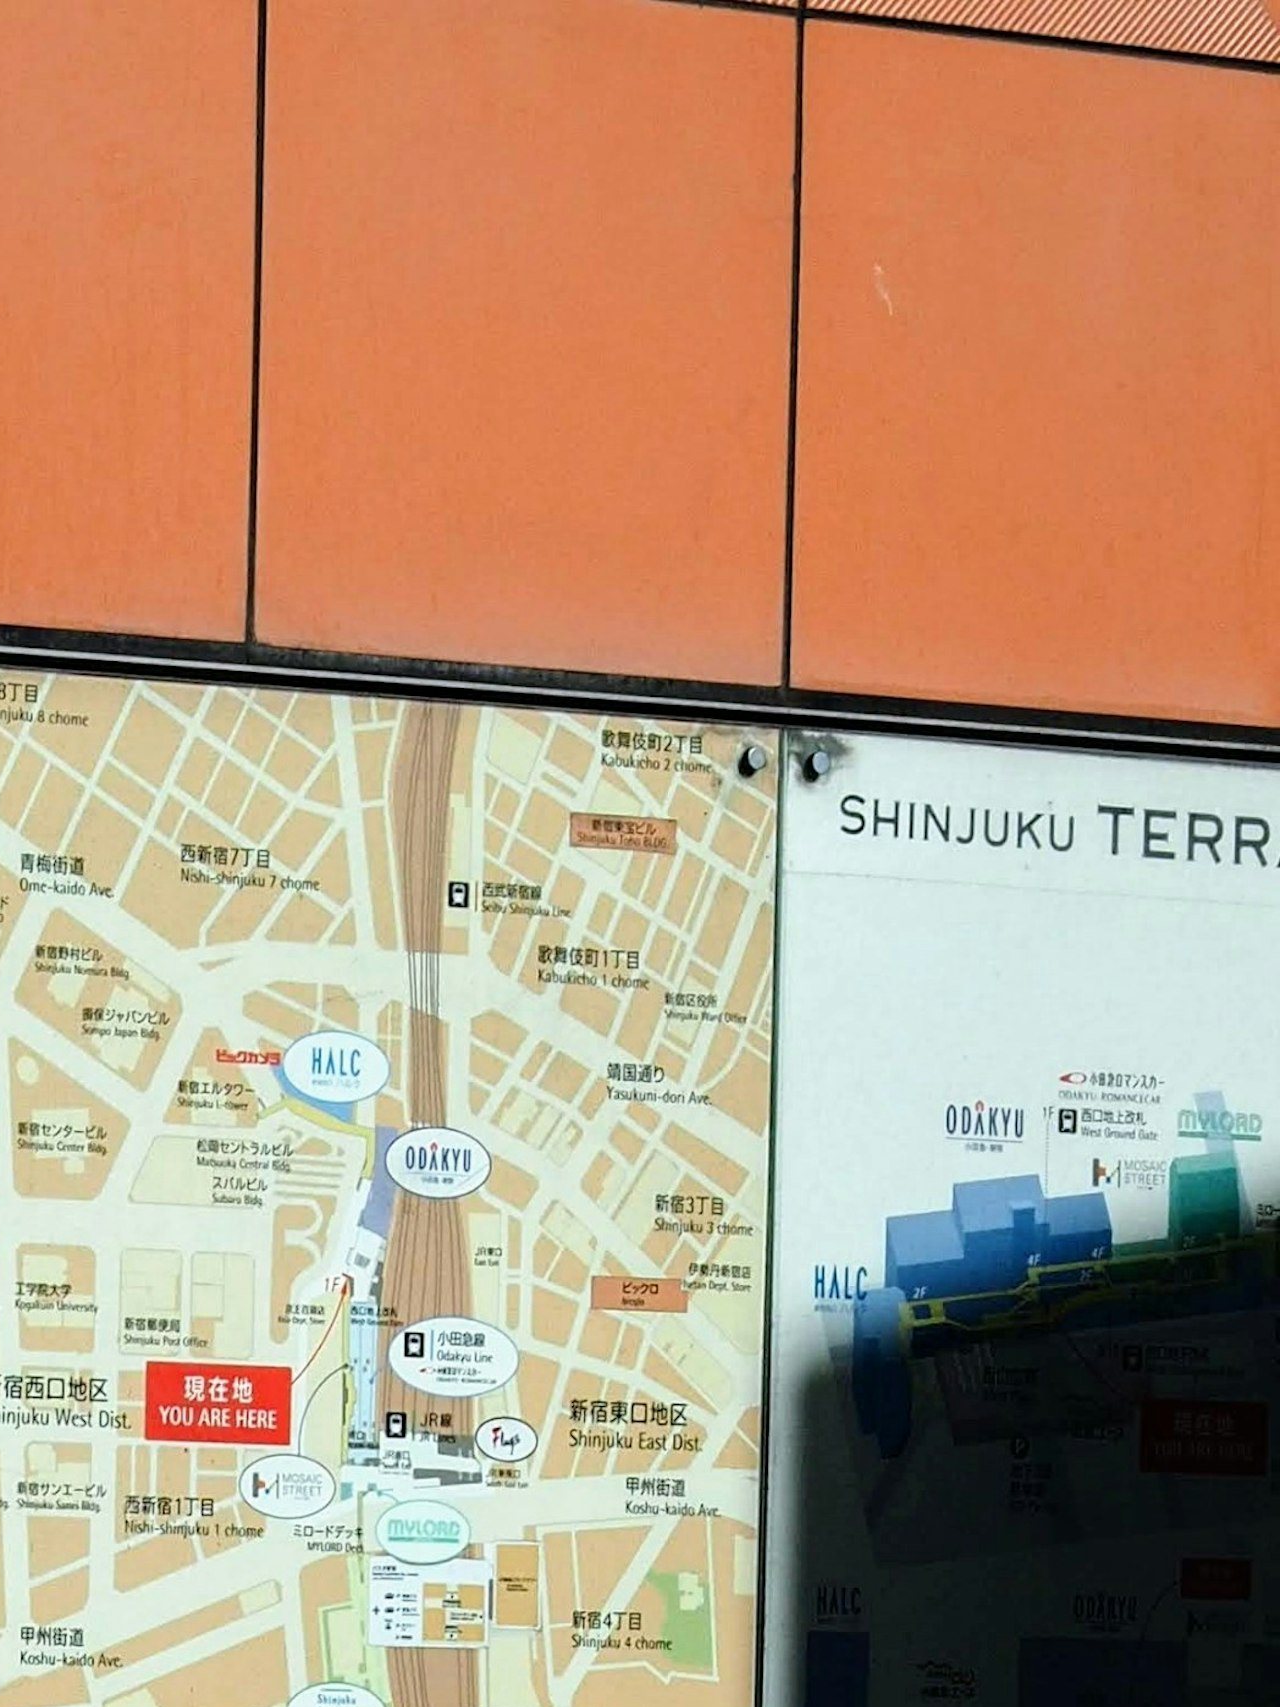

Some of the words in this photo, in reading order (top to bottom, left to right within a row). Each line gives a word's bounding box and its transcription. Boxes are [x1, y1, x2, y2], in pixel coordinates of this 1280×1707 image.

[37, 705, 46, 723] 8
[48, 709, 90, 727] chome
[601, 730, 703, 754] 歌舞伎町2丁目
[601, 755, 661, 771] Kabukicho
[663, 757, 671, 771] 2
[674, 759, 713, 775] chome
[839, 794, 1075, 853] SHINJUKU
[1097, 803, 1280, 868] TERR
[20, 853, 85, 877] 青梅街道
[180, 843, 271, 868] 西新宿7丁目
[19, 877, 86, 897] Ome-kaido
[89, 881, 115, 898] Ave.
[180, 868, 266, 889] Nishi-shinjuku
[268, 874, 277, 888] 7
[280, 875, 320, 891] chome
[538, 945, 641, 970] 歌舞伎町1丁目
[537, 969, 598, 987] Kabukicho
[601, 973, 608, 987] 1
[611, 974, 650, 990] chome
[311, 1047, 362, 1077] HALC
[607, 1063, 666, 1083] 靖国通り
[606, 1088, 686, 1106] Yasukuni-dori
[688, 1091, 714, 1106] Ave.
[945, 1100, 1025, 1138] ODAKYU
[1081, 1108, 1147, 1126] 西口地上改札
[405, 1142, 472, 1173] ODAKYU
[655, 1194, 725, 1216] 新宿3丁目
[654, 1218, 703, 1238] Shinjuku
[706, 1221, 714, 1235] 3
[717, 1222, 754, 1237] chome
[324, 1277, 340, 1293] 1F
[815, 1265, 868, 1301] HALC
[184, 1375, 253, 1403] 現在地
[55, 1407, 92, 1429] West
[98, 1409, 132, 1430] Dist.
[159, 1406, 194, 1427] YOU
[198, 1407, 231, 1428] ARE
[236, 1408, 278, 1430] HERE
[569, 1399, 689, 1427] 新宿東口地区
[569, 1429, 633, 1453] Shinjuku
[638, 1430, 668, 1451] East
[672, 1431, 703, 1452] Dist.
[626, 1477, 686, 1498] 甲州街道
[124, 1495, 215, 1517] 西新宿1丁目
[625, 1501, 695, 1517] Koshu-kaido
[697, 1503, 721, 1517] Ave.
[124, 1519, 210, 1540] Nishi-shinjuku
[214, 1523, 220, 1537] 1
[224, 1522, 264, 1539] chome
[293, 1524, 364, 1540] ミロードデッキ
[572, 1611, 642, 1631] 新宿4丁目
[20, 1627, 85, 1648] 甲州街道
[571, 1634, 621, 1651] Shinjuku
[624, 1635, 632, 1649] 4
[635, 1635, 673, 1650] chome
[19, 1650, 95, 1668] Koshu-kaido
[97, 1653, 124, 1668] Ave.
